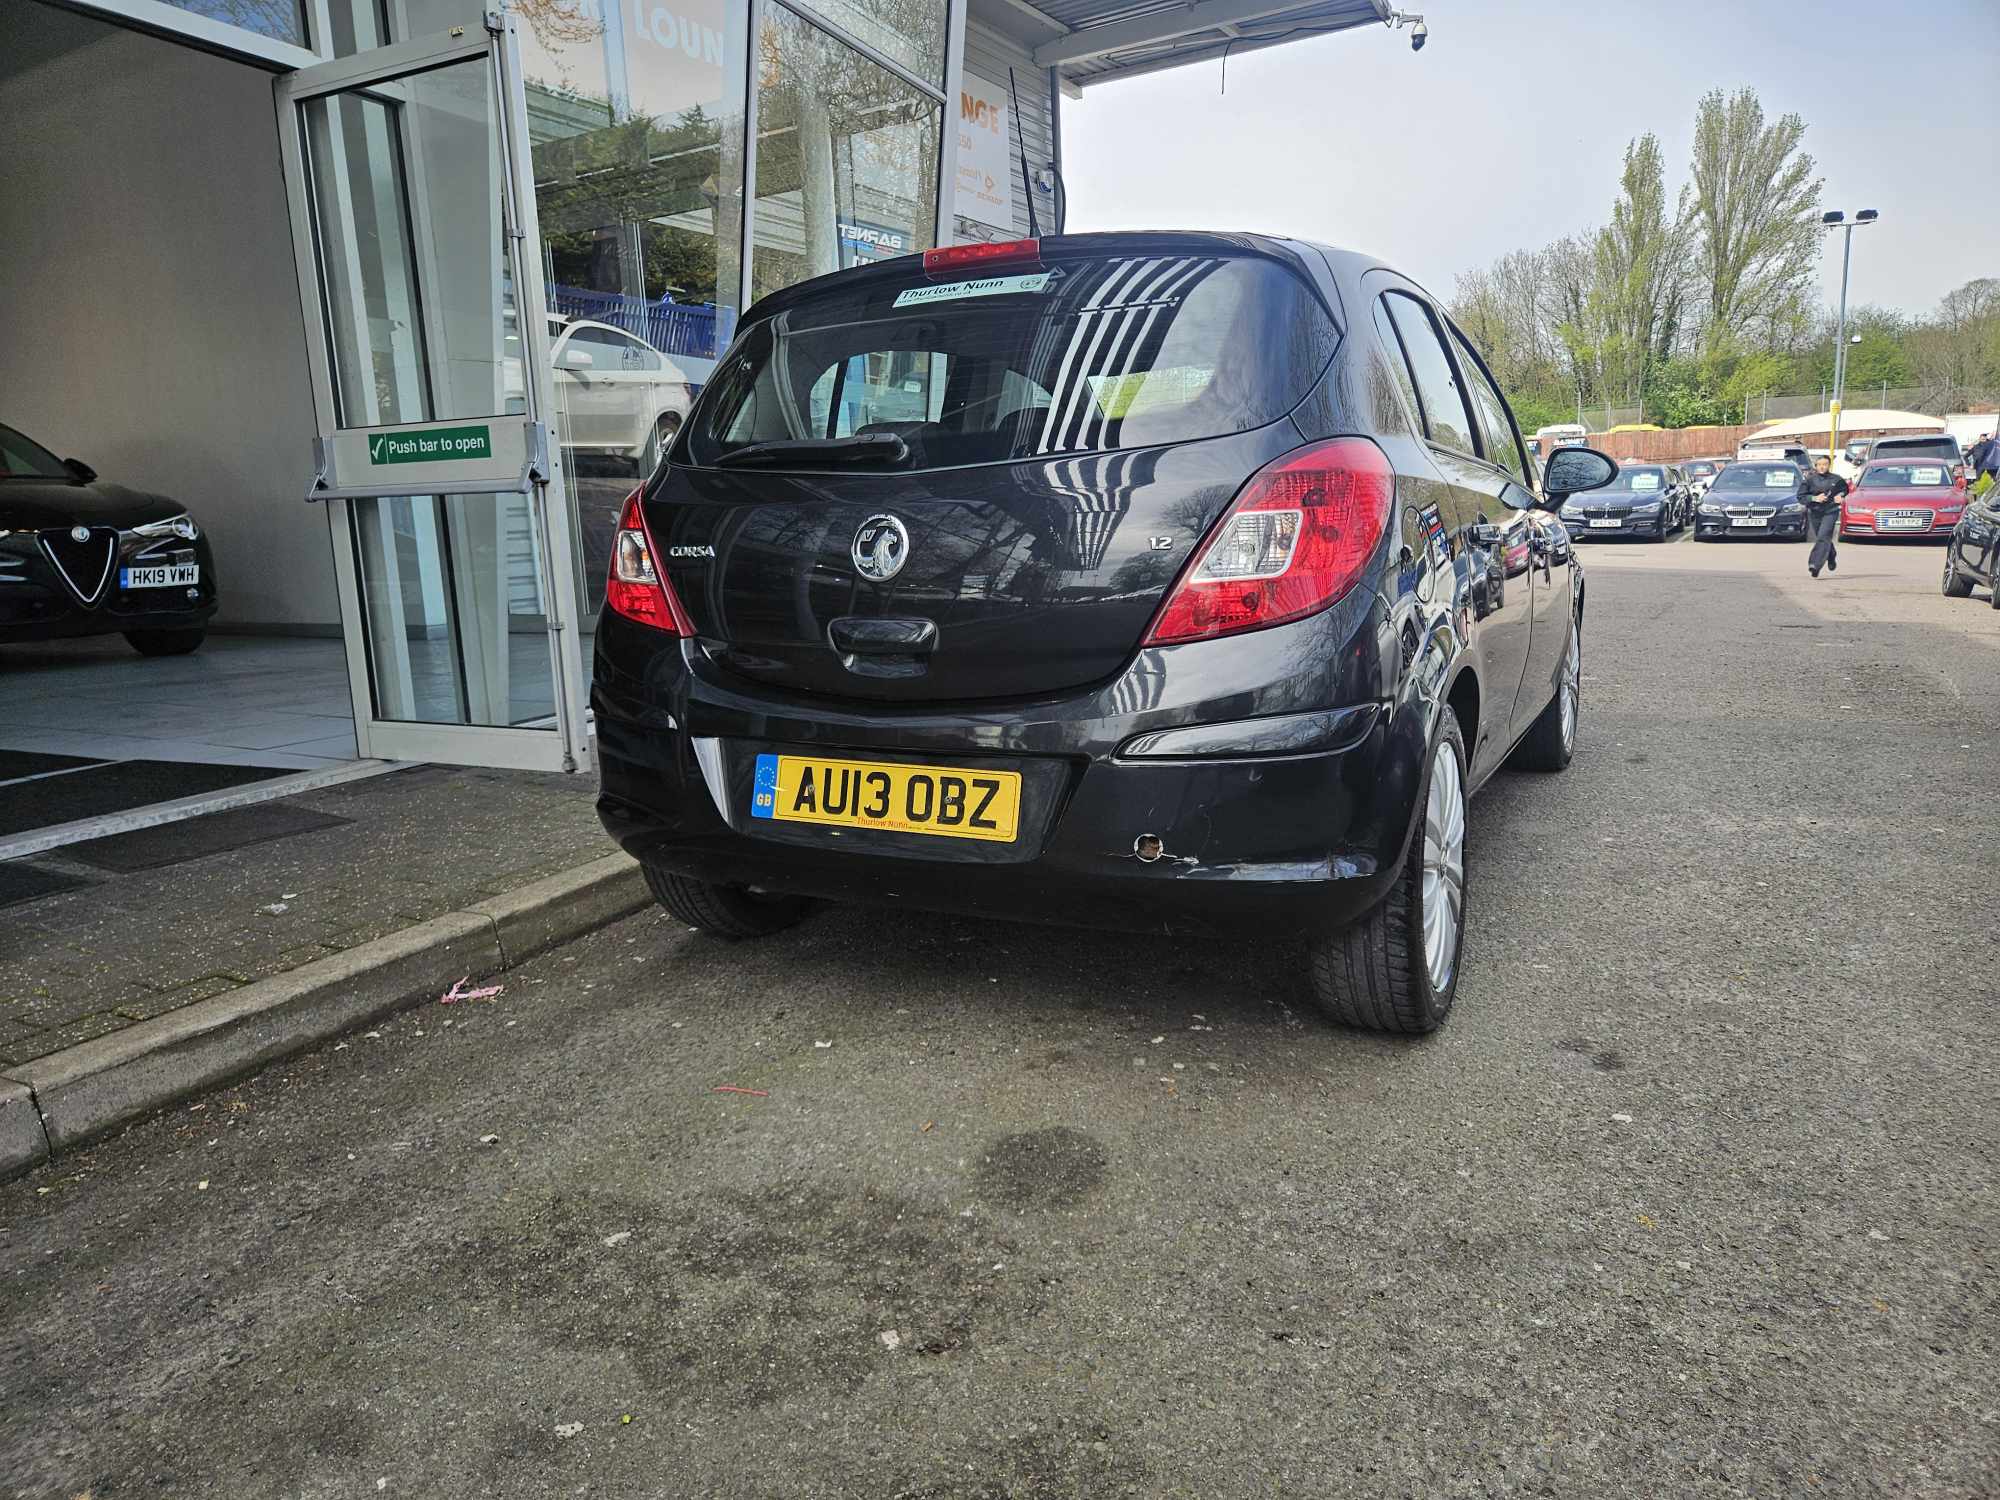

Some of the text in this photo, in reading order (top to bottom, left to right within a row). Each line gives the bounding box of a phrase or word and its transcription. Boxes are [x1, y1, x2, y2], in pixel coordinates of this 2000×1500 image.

[902, 285, 960, 300] Thurlow
[964, 280, 1004, 291] Nunn
[388, 437, 485, 454] Push bar to open
[669, 544, 716, 558] CORSA
[132, 567, 195, 585] HK19 VWH
[755, 792, 772, 808] GB
[793, 766, 1000, 830] AU13 OBZ
[857, 816, 908, 829] Thurlow Nunn
